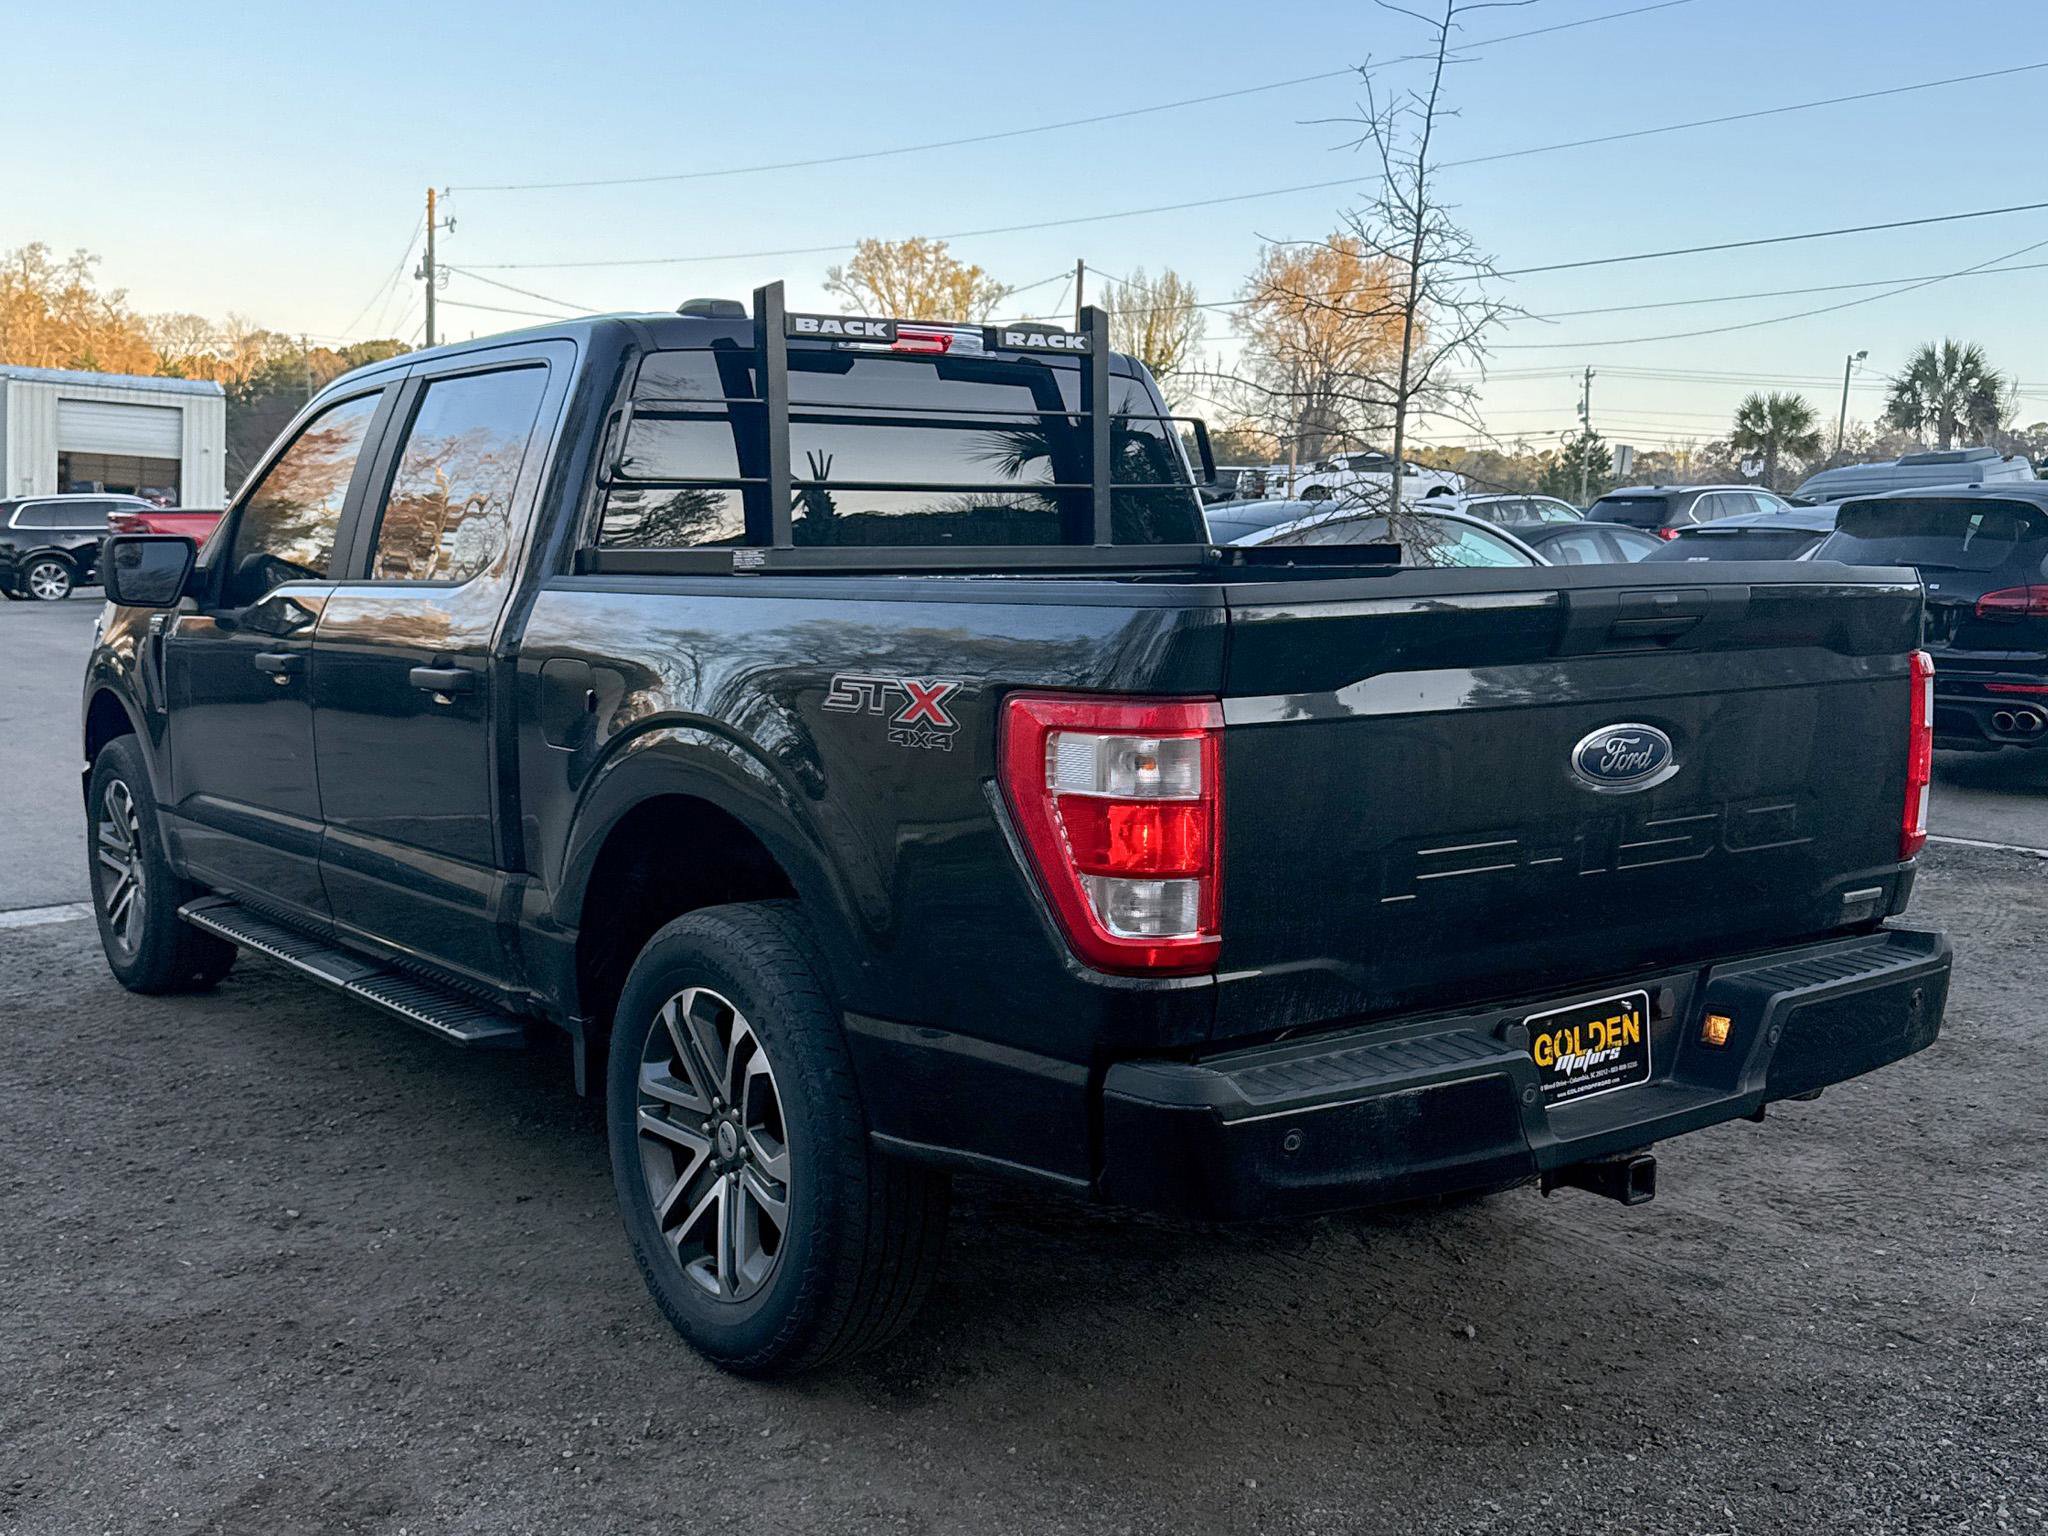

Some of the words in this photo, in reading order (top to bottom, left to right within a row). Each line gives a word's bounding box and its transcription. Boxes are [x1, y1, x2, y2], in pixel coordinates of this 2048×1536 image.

[796, 317, 888, 337] BACK
[1005, 331, 1086, 349] RACK
[822, 672, 964, 735] STX
[1600, 737, 1653, 773] Ford
[1534, 1011, 1640, 1067] GOLDEN
[1554, 1047, 1621, 1076] Motors
